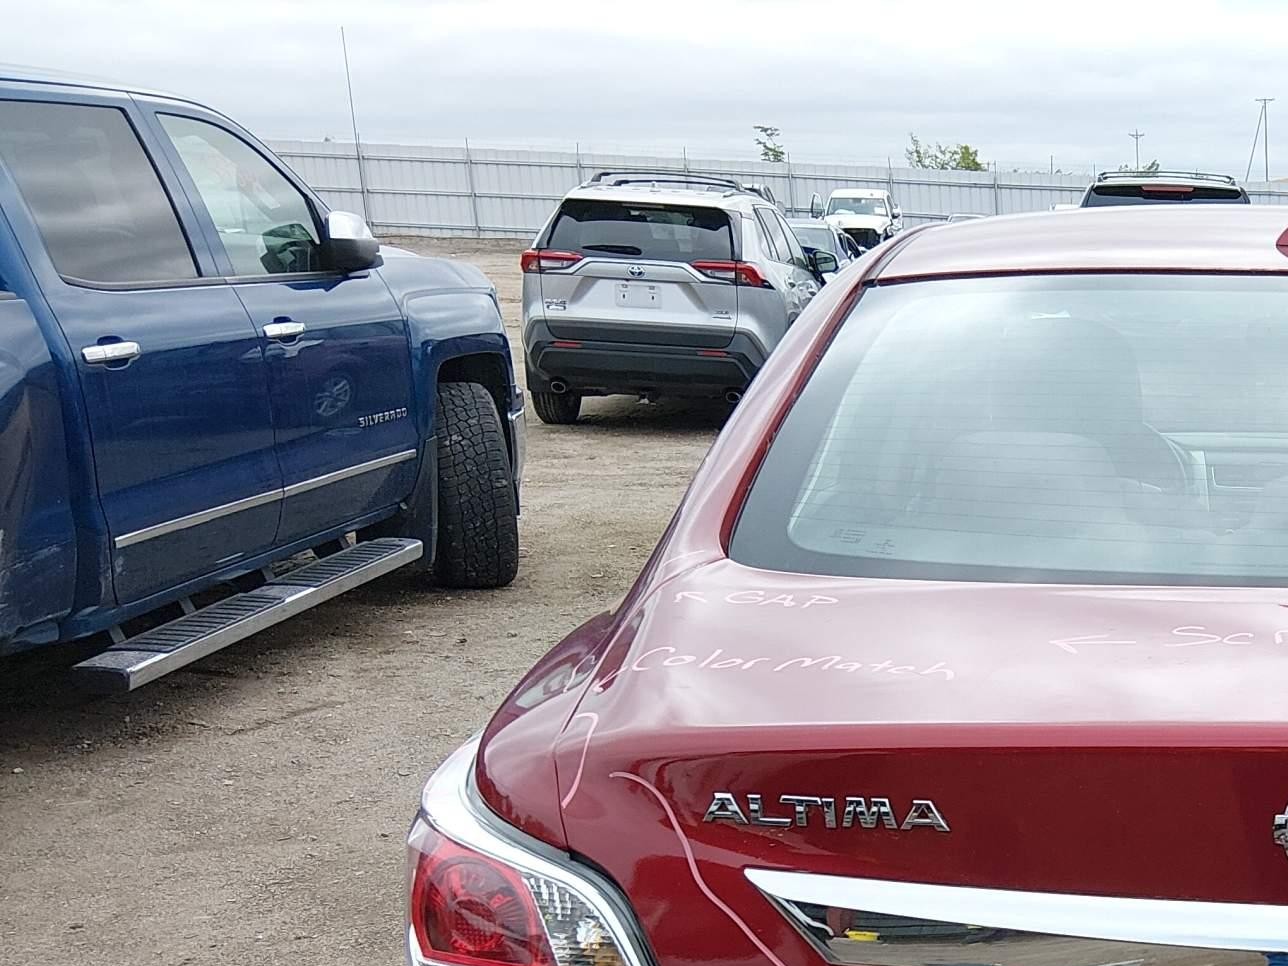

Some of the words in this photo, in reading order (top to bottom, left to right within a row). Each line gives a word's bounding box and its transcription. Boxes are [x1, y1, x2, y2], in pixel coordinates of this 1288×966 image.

[358, 407, 408, 428] SILVERADO
[726, 590, 839, 609] GAP
[632, 646, 770, 671] Color
[773, 654, 955, 681] Match
[702, 791, 951, 832] ALTIMA
